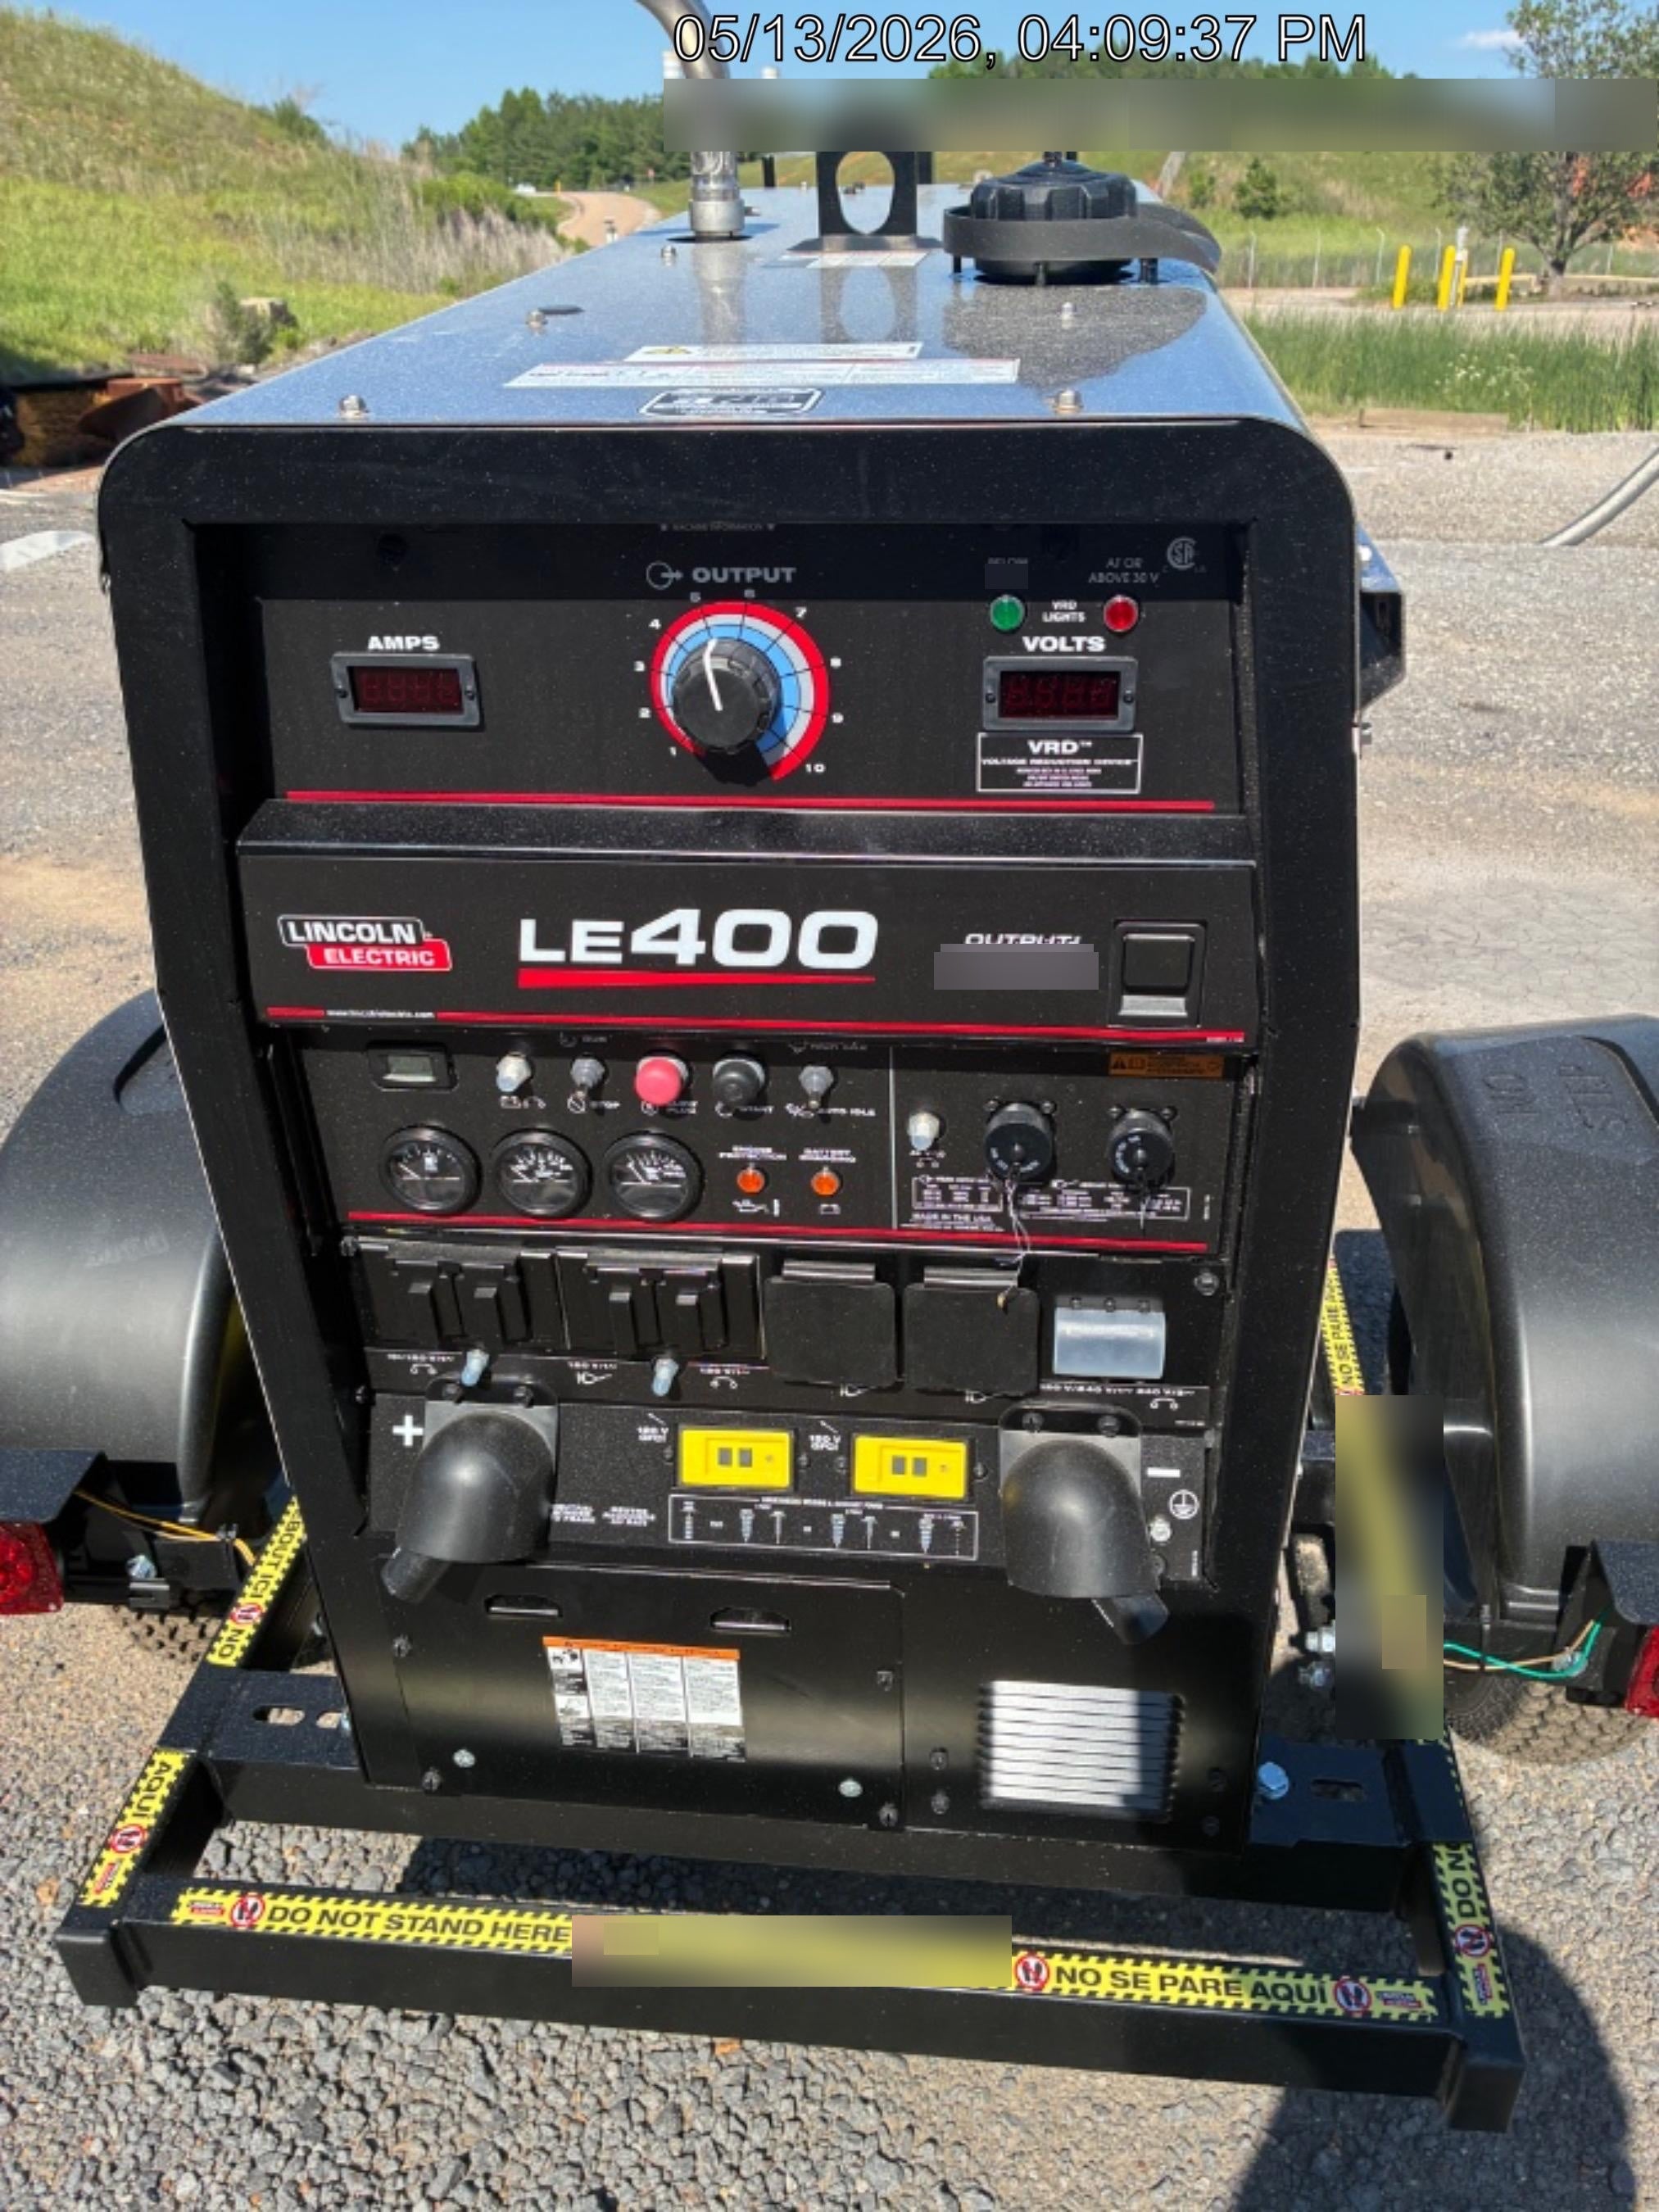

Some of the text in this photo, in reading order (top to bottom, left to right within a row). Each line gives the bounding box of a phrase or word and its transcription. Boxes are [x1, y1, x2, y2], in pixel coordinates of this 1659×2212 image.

[691, 566, 796, 583] OUTPUT
[795, 606, 807, 619] 7
[648, 619, 662, 630] 4
[367, 635, 441, 651] AMPS
[1022, 636, 1106, 653] VOLTS
[669, 746, 677, 757] 1
[805, 763, 826, 773] 10
[287, 920, 417, 945] LINCOLN
[519, 908, 879, 970] LE400
[323, 948, 436, 967] ELECTRIC
[218, 1629, 248, 1660] NO
[1453, 1877, 1478, 1919] DO
[266, 1906, 571, 1943] DO NOT STAND HERE
[1055, 1965, 1102, 1986] NO
[1109, 1970, 1151, 1991] SE
[1158, 1974, 1243, 1997] PARE
